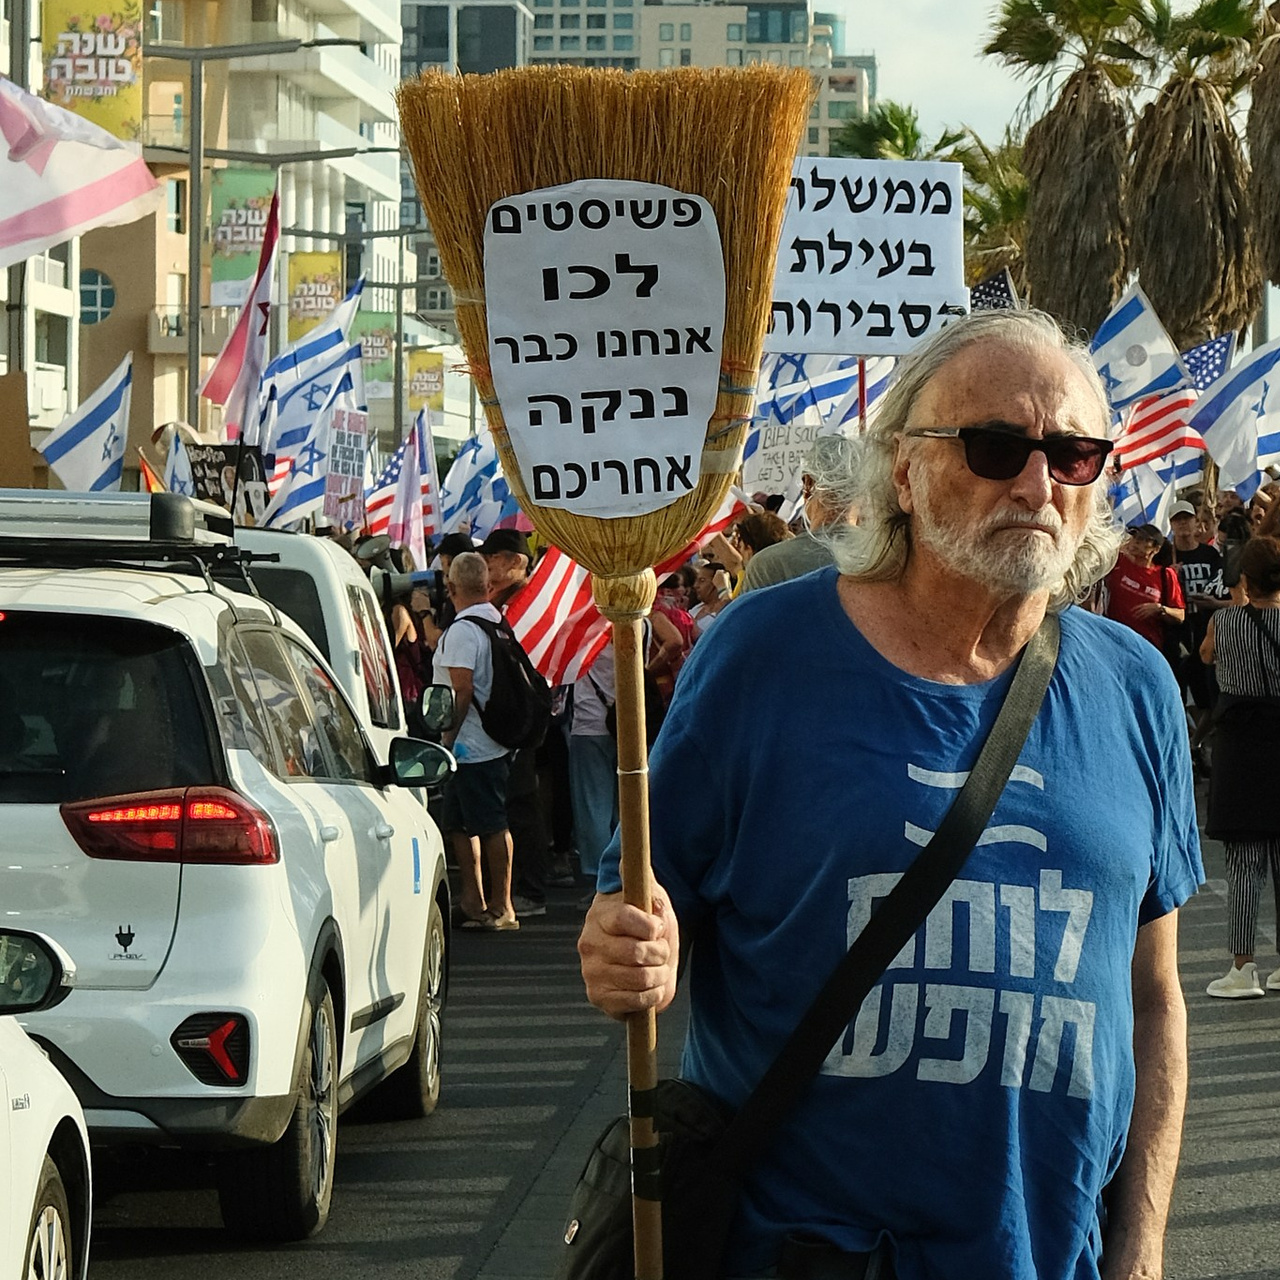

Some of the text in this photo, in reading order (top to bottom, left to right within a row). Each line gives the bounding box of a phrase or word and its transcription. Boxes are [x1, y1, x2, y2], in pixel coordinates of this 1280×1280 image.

[57, 32, 126, 56] שנה
[50, 58, 133, 81] טובה
[221, 209, 268, 225] שנה
[491, 198, 702, 234] פשיסטים
[789, 228, 937, 279] בעילת
[296, 283, 331, 296] שנה
[541, 253, 659, 301] לכו
[292, 296, 335, 309] טובה
[494, 326, 714, 364] אנחנו כבר
[527, 386, 689, 434] ננקה
[532, 455, 694, 500] אחריכם
[819, 983, 1096, 1100] חופש
